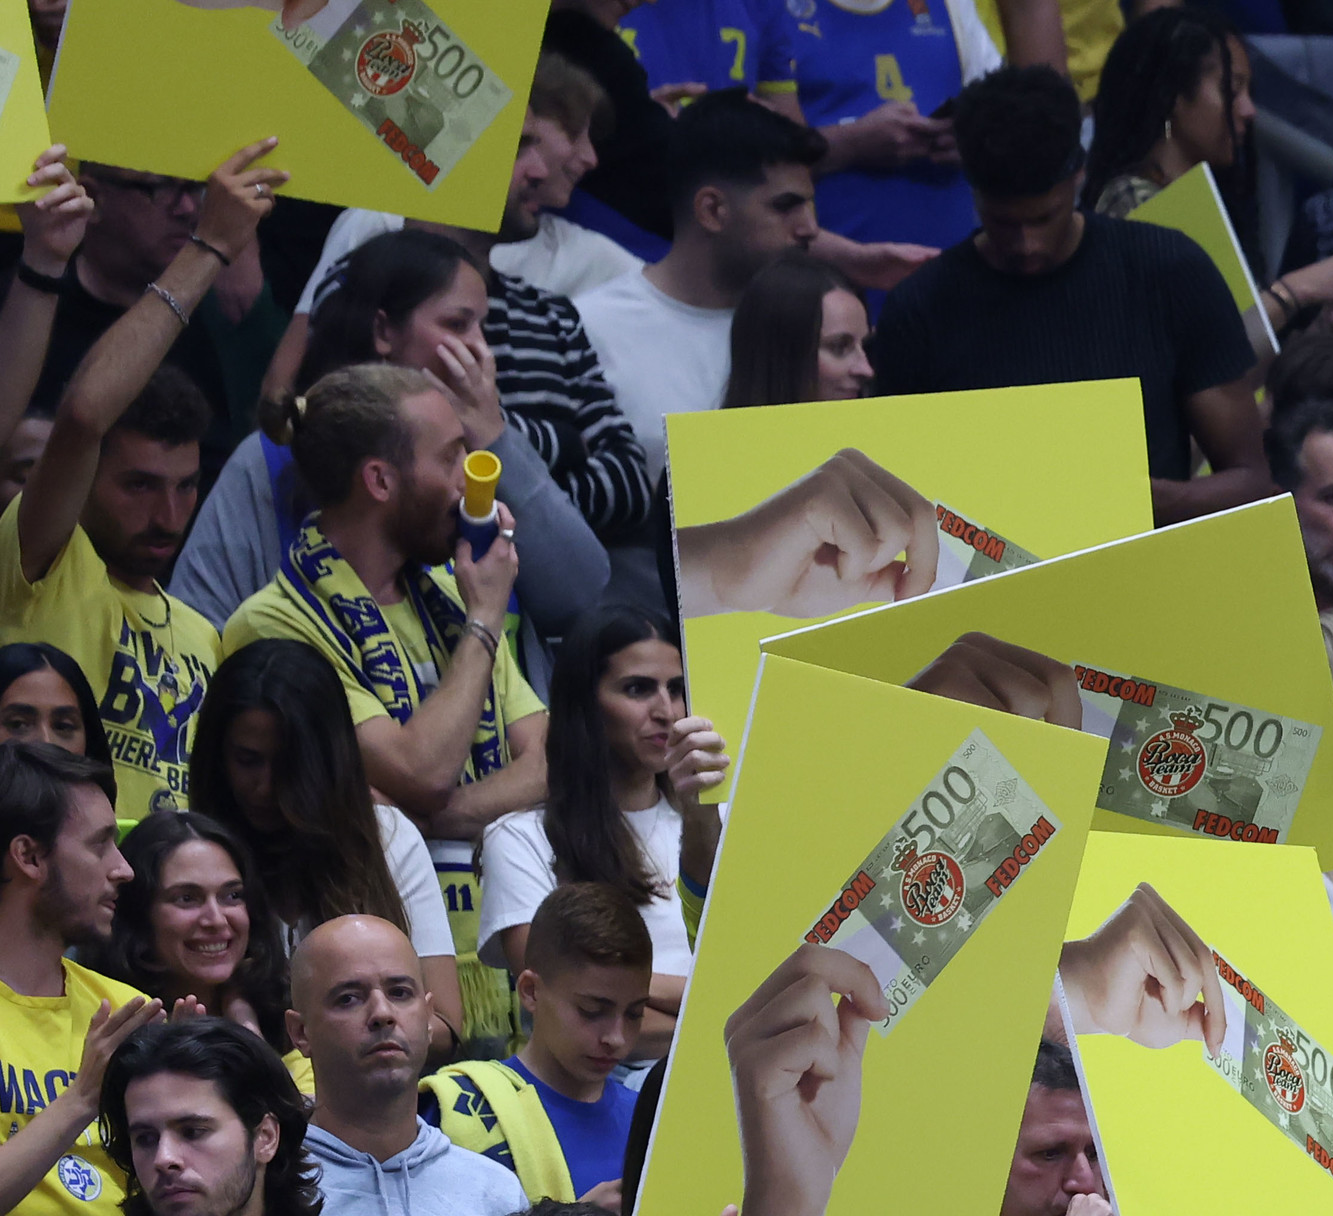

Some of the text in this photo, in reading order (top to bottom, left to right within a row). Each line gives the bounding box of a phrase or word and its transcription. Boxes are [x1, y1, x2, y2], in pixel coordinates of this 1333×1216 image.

[417, 27, 484, 99] 500
[376, 118, 440, 186] FEDCOM
[1198, 703, 1284, 759] 500
[1292, 726, 1308, 738] 500
[901, 765, 976, 853] 500
[1149, 779, 1178, 795] BASKET
[985, 816, 1056, 898] FEDCOM
[1193, 809, 1280, 845] FEDCOM
